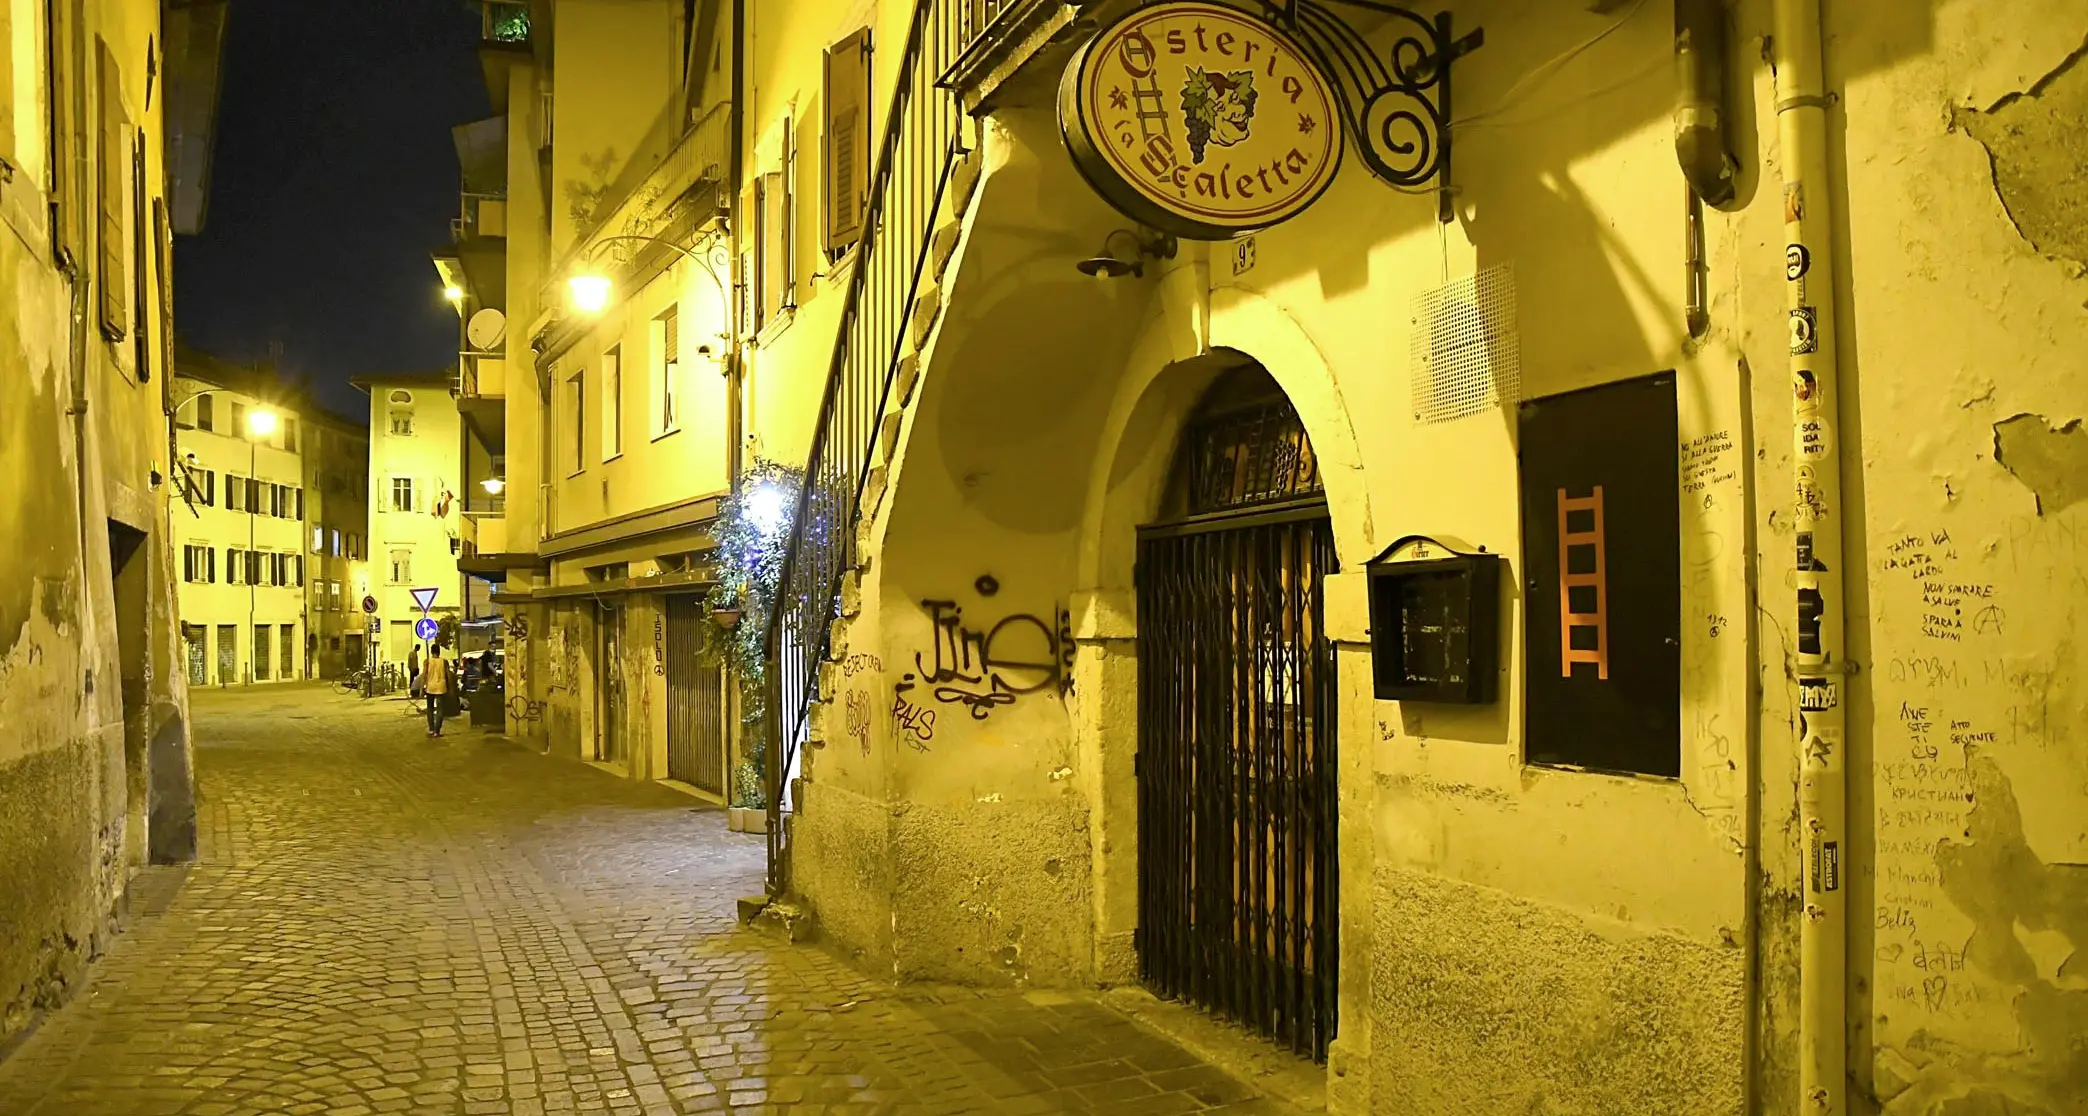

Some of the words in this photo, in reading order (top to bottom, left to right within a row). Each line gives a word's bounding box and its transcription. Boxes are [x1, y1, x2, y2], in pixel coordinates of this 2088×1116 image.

[1119, 20, 1304, 105] Osteria
[1113, 119, 1136, 149] la
[1138, 132, 1309, 200] Scaletta
[1238, 243, 1247, 268] 9
[1802, 423, 1821, 432] SOL
[1803, 433, 1819, 443] IDA
[1803, 445, 1825, 454] RITY
[1887, 534, 1924, 556] TANTO
[1930, 528, 1952, 545] VA
[1945, 549, 1958, 561] AL
[1923, 581, 1944, 594] NON
[1922, 625, 1962, 642] SALVINI
[1892, 787, 1963, 802] КРИСТИАН
